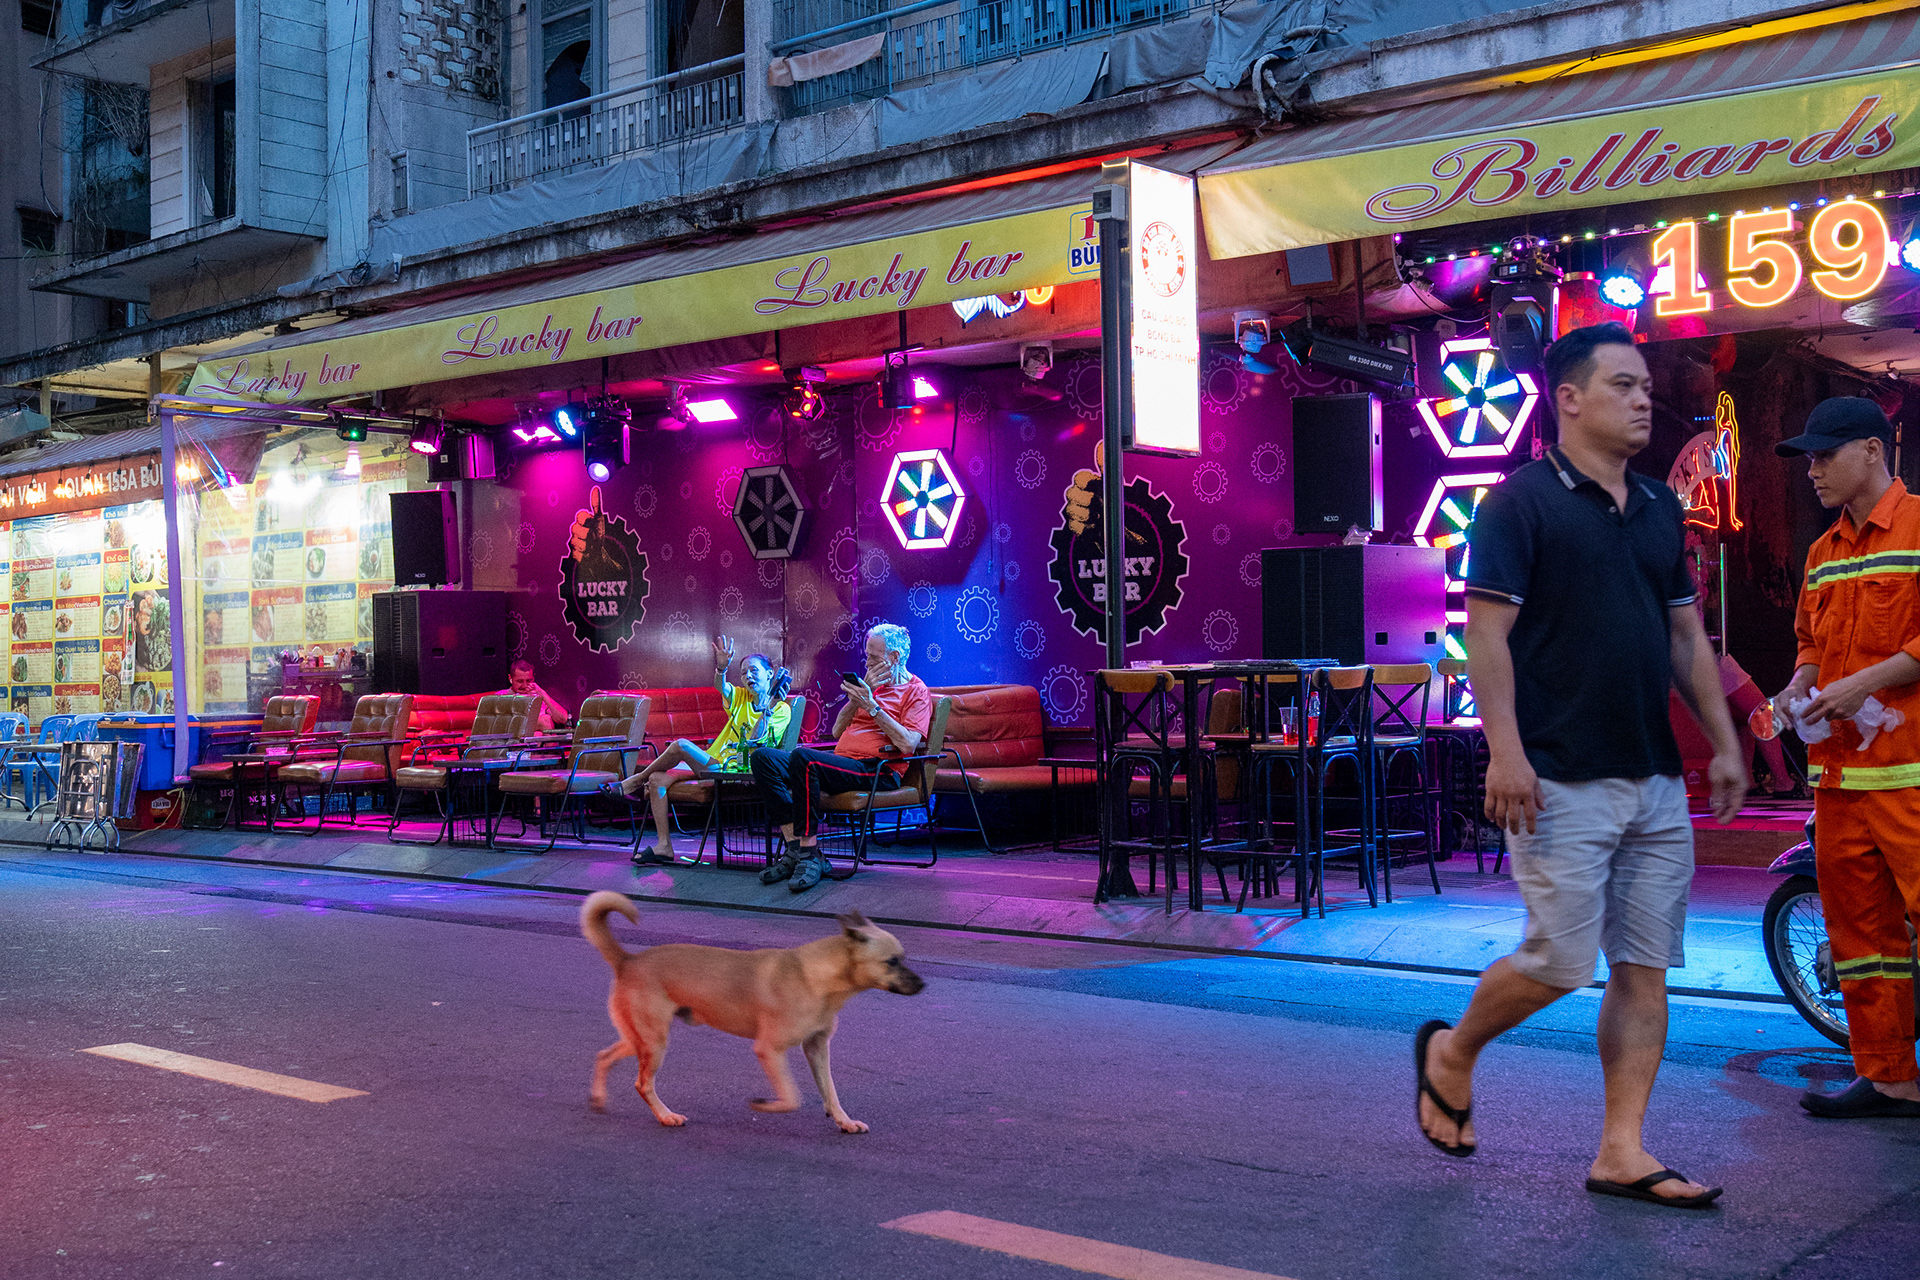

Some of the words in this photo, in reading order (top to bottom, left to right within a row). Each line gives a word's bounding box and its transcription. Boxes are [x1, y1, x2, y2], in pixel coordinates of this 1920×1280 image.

[1365, 94, 1897, 223] Billiards
[1653, 199, 1890, 317] 159
[753, 252, 928, 315] Lucky
[945, 240, 1025, 285] bar
[441, 313, 574, 366] Lucky
[586, 306, 643, 343] bar
[193, 357, 309, 400] Lucky
[319, 353, 361, 386] bar
[1382, 363, 1393, 371] PRO
[1077, 556, 1155, 579] LUKY
[578, 580, 628, 598] LUCKY
[1092, 582, 1141, 602] BR
[587, 601, 618, 617] BAR
